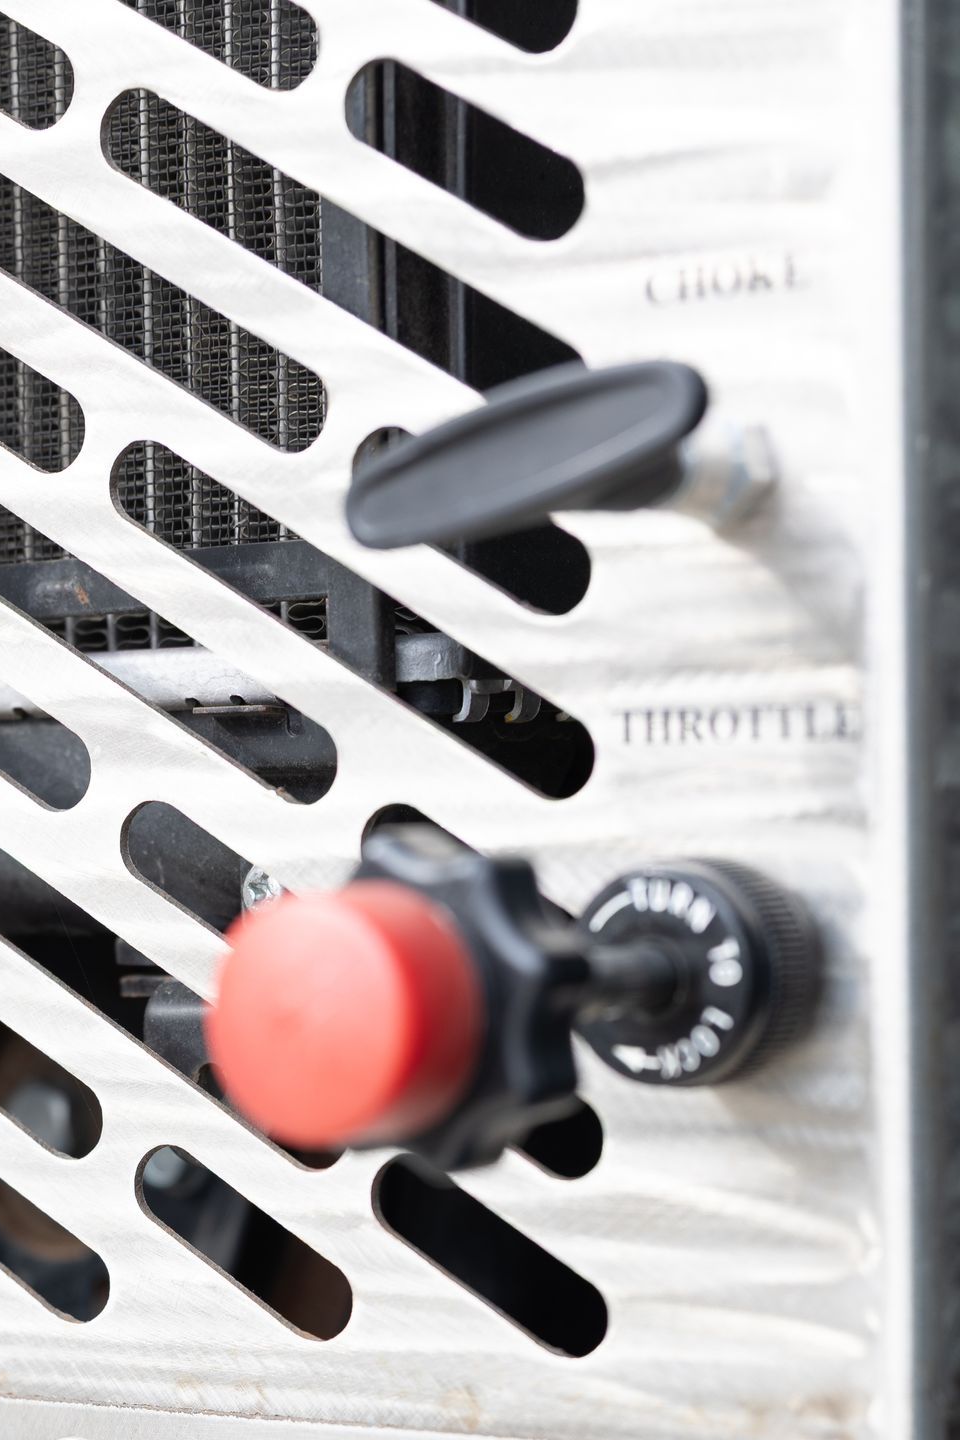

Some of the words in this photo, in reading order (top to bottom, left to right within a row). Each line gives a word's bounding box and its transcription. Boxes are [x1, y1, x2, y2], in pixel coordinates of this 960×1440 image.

[613, 701, 862, 745] THROTTLE
[628, 877, 716, 933] TURN
[707, 936, 742, 987] TO
[656, 1006, 734, 1080] LOCK
